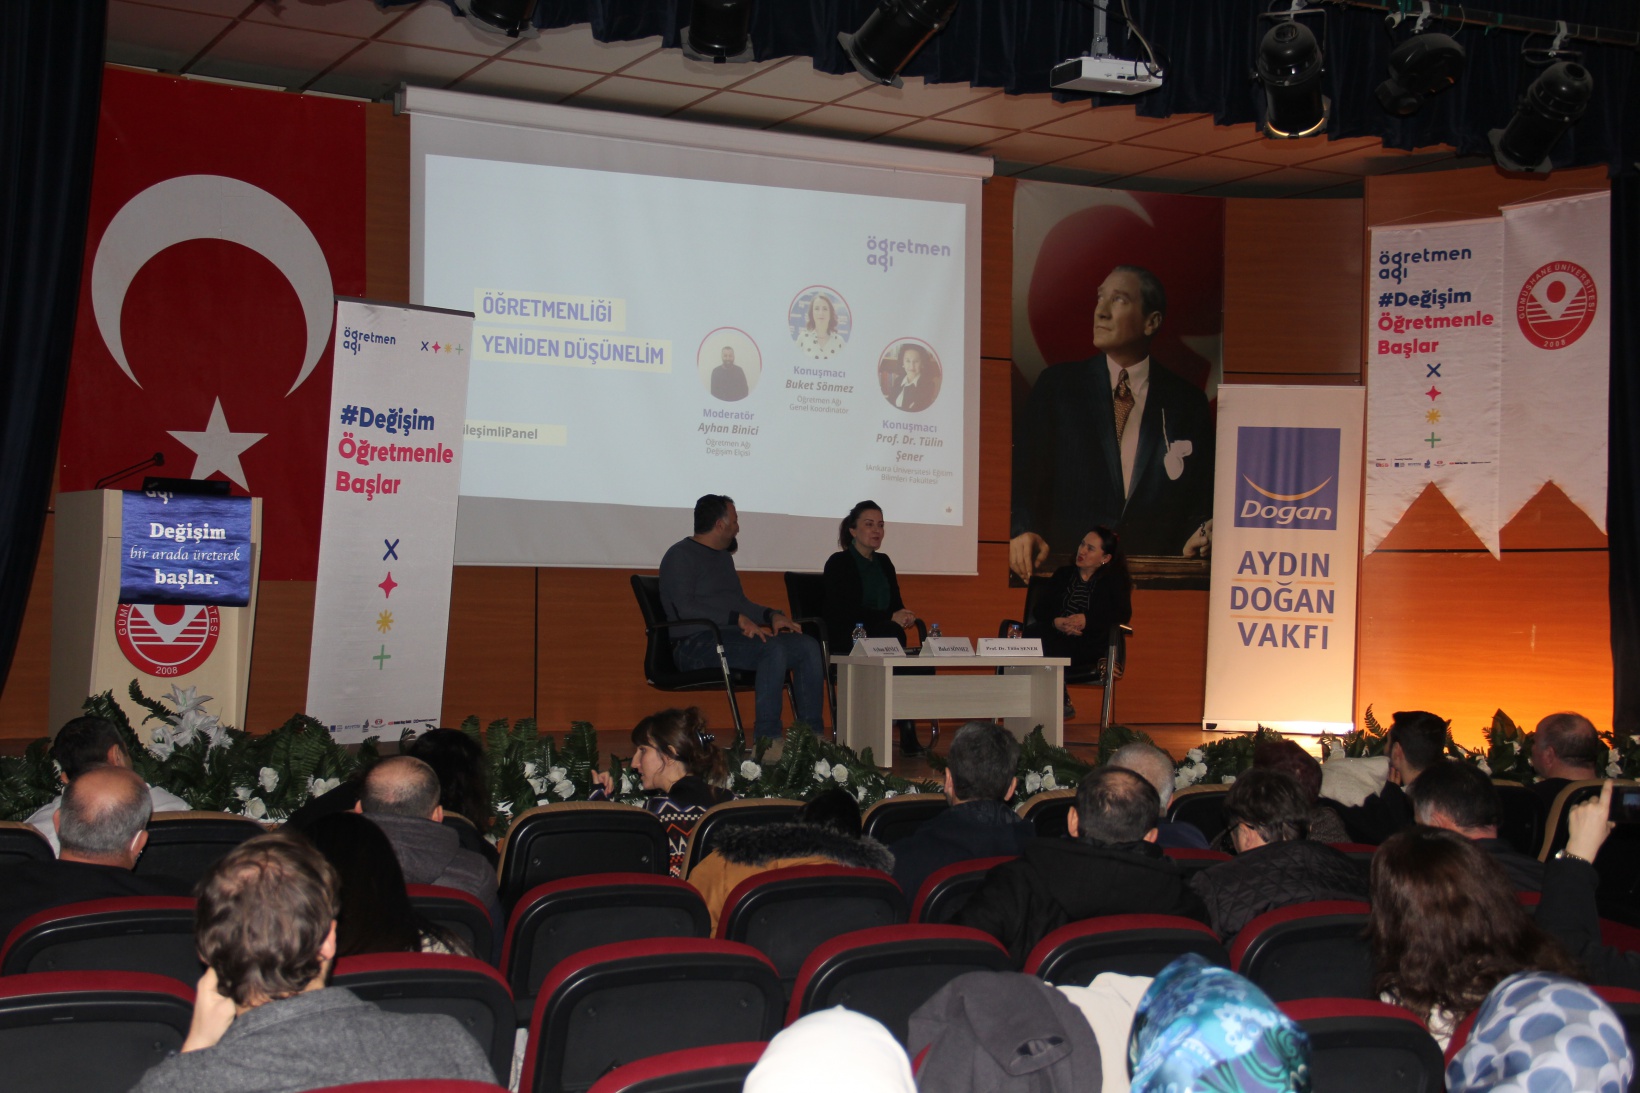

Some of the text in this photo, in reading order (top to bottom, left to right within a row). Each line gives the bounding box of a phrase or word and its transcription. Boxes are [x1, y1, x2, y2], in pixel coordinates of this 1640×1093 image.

[482, 291, 613, 322] ÖĞRETMENLİĞİ
[1378, 287, 1472, 309] #Değişim
[1377, 310, 1494, 334] Öğretmenle
[481, 333, 665, 366] YENİDEN DÜŞÜNELİM
[1377, 338, 1439, 359] Başlar
[1543, 339, 1566, 348] 2008
[793, 365, 846, 379] Konuşmacı
[785, 379, 855, 394] Buket Sönmez
[702, 408, 755, 421] Moderatör
[789, 403, 810, 413] Genel
[340, 404, 435, 437] #Değişim
[697, 422, 760, 436] Ayhan Binici
[882, 419, 938, 433] Konuşmacı
[338, 431, 454, 467] Öğretmenle
[876, 433, 944, 447] Prof. Dr. Tülin
[895, 450, 925, 463] Şener
[335, 470, 402, 501] Başlar
[149, 522, 227, 544] Değişim
[130, 544, 242, 561] bir arada üreterek
[1237, 550, 1331, 578] AYDIN
[154, 568, 220, 590] başlar.
[1229, 580, 1336, 615] DOĞAN
[1236, 621, 1329, 650] VAKFI
[155, 665, 179, 675] 2008
